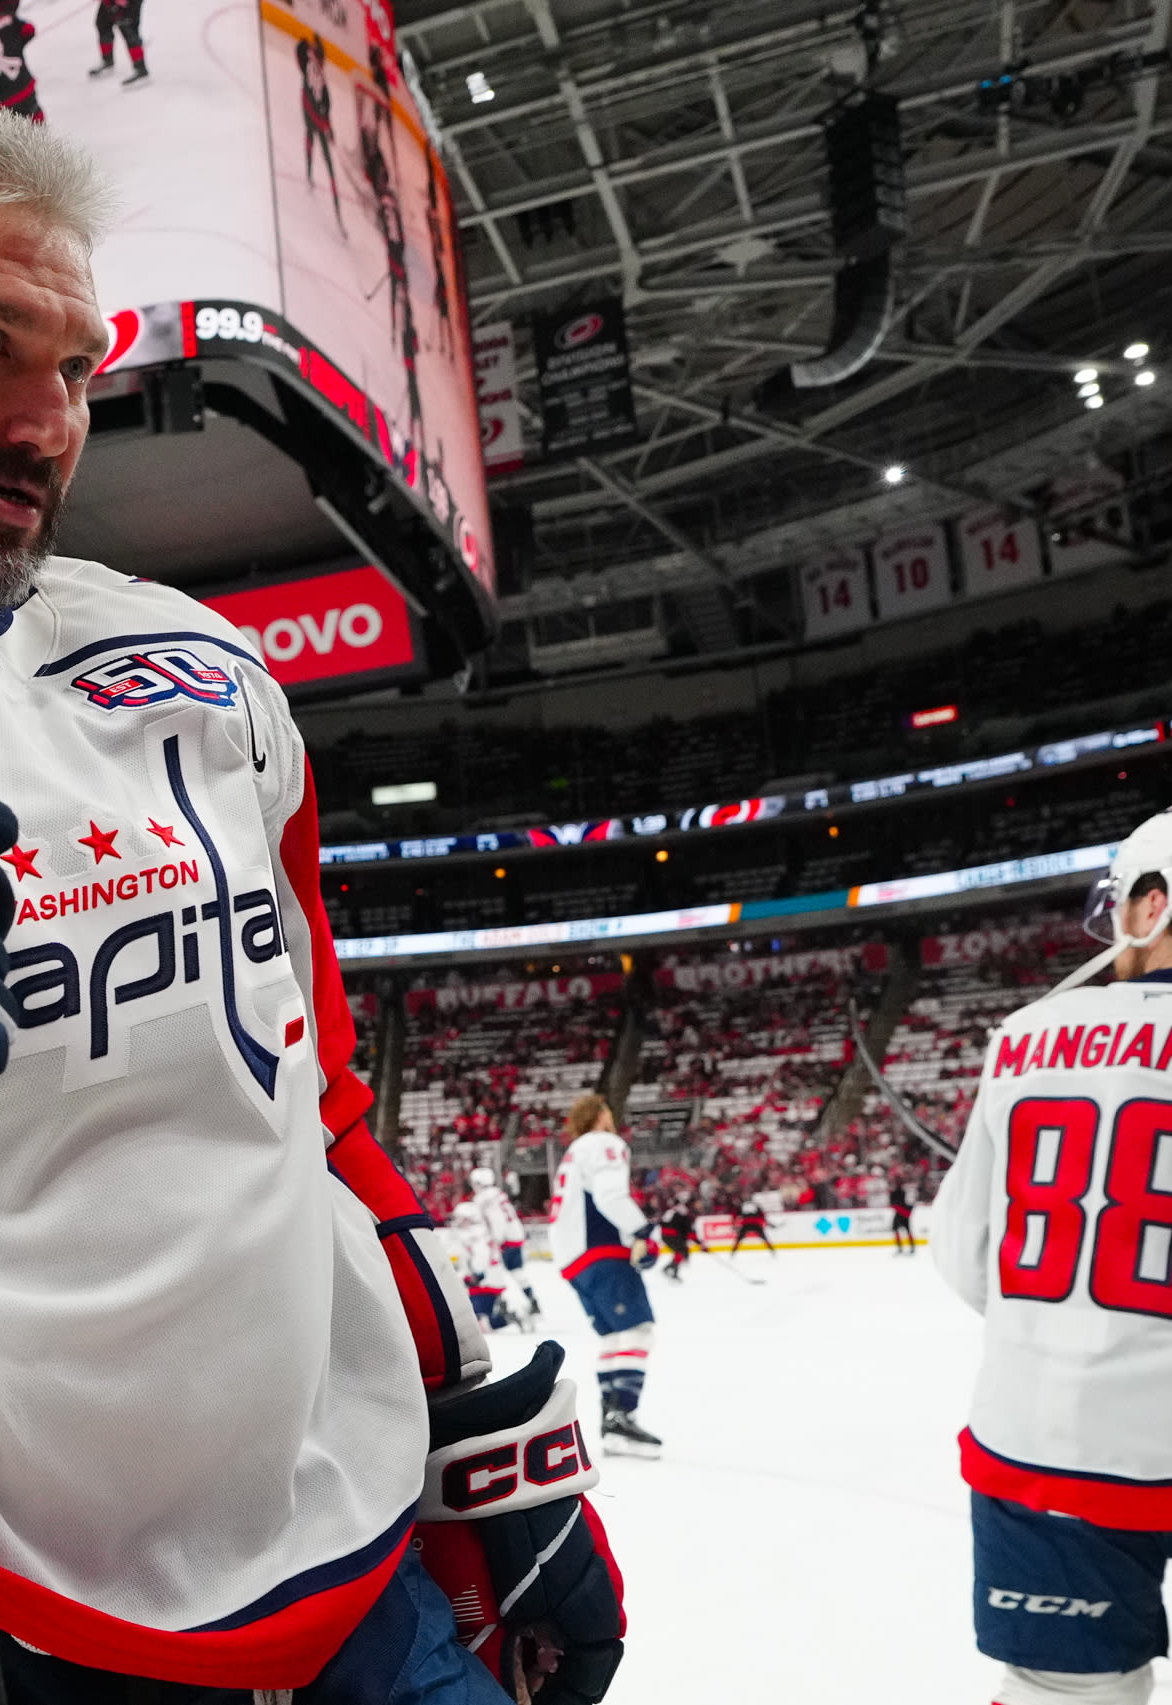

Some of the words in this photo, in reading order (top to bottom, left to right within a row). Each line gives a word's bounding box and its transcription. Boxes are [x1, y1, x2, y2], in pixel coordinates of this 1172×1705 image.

[195, 307, 264, 343] 99.9
[980, 531, 1021, 571] 14
[893, 557, 930, 594] 10
[819, 579, 853, 615] 14
[71, 649, 233, 704] 50
[109, 681, 135, 694] EST
[196, 671, 225, 680] 1974
[15, 859, 200, 926] ASHINGTON
[436, 976, 593, 1012] BUFFALO
[999, 1096, 1172, 1319] 88
[988, 1586, 1113, 1618] CCM
